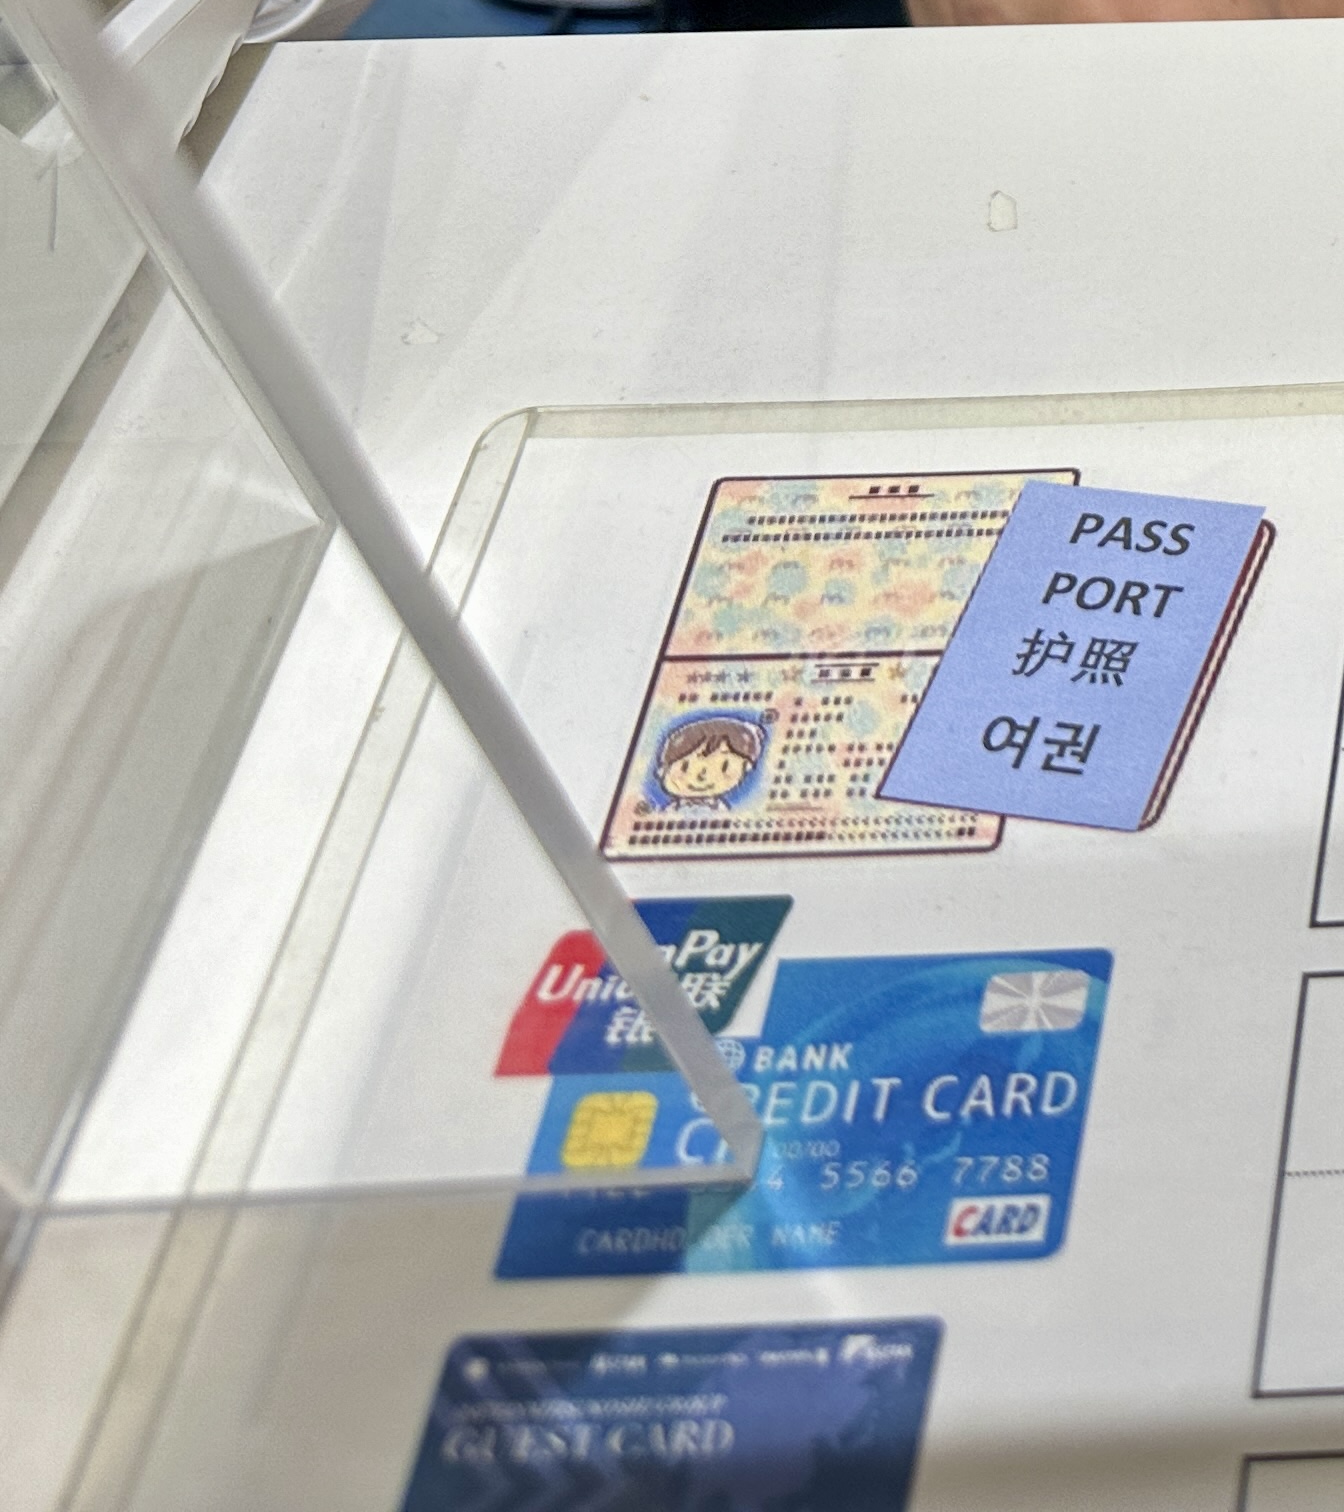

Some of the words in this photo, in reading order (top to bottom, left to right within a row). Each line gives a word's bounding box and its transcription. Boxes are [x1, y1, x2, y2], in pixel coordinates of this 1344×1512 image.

[1069, 512, 1196, 556] PASS
[1041, 571, 1185, 619] PORT
[1011, 627, 1140, 687] 护照
[982, 715, 1102, 776] 여권
[753, 1042, 852, 1072] BANK
[690, 1076, 901, 1127] EDIT
[921, 1070, 1079, 1122] CARD
[820, 1159, 918, 1190] 5566
[952, 1153, 1050, 1185] 7788
[953, 1202, 1041, 1237] CARD
